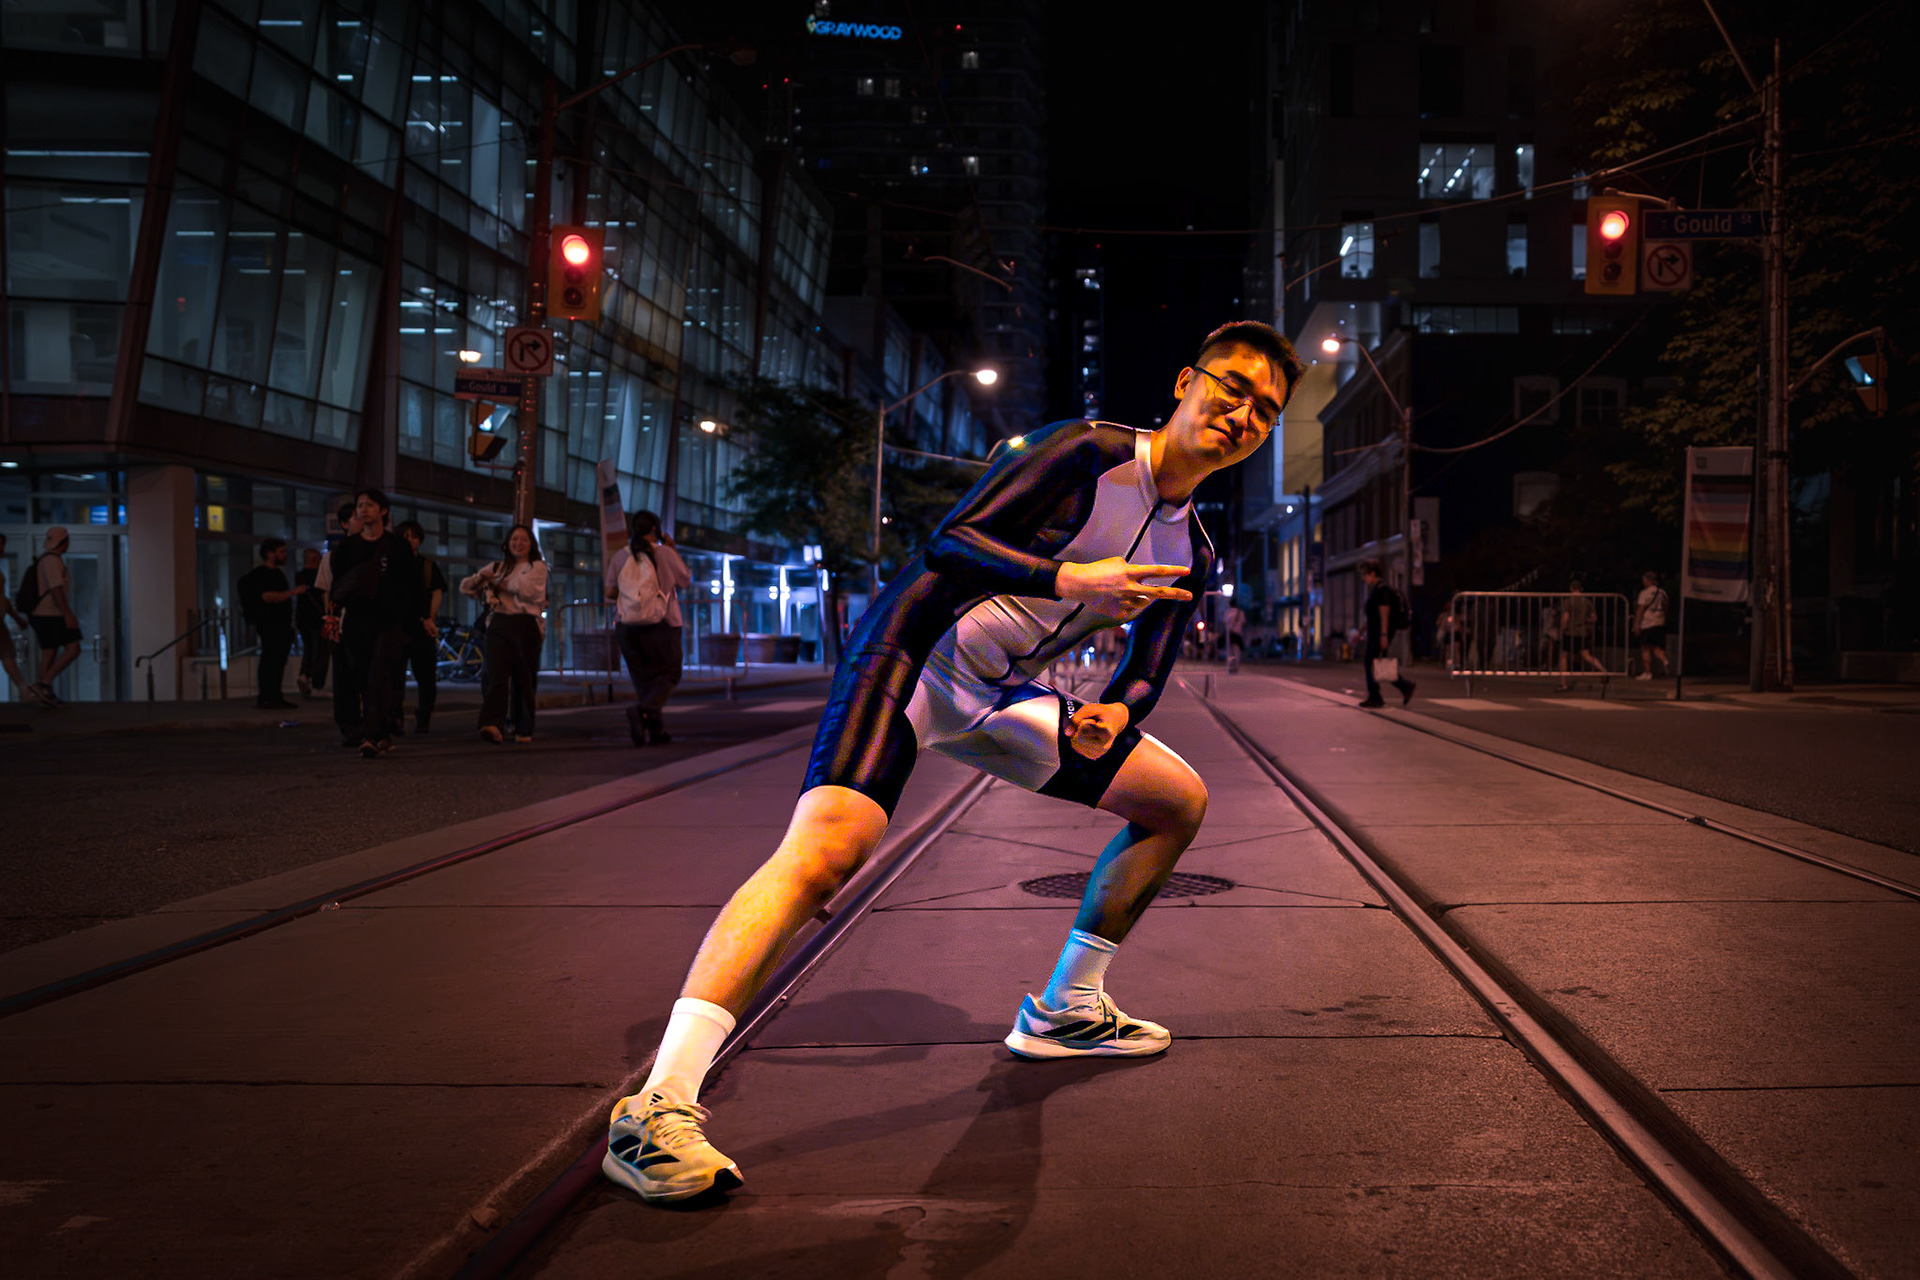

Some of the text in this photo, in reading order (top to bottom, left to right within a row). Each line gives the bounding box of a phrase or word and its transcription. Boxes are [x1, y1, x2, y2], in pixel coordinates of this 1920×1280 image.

[815, 20, 903, 40] GRAYWOOD
[1674, 214, 1732, 234] Gould
[468, 380, 497, 393] Gould
